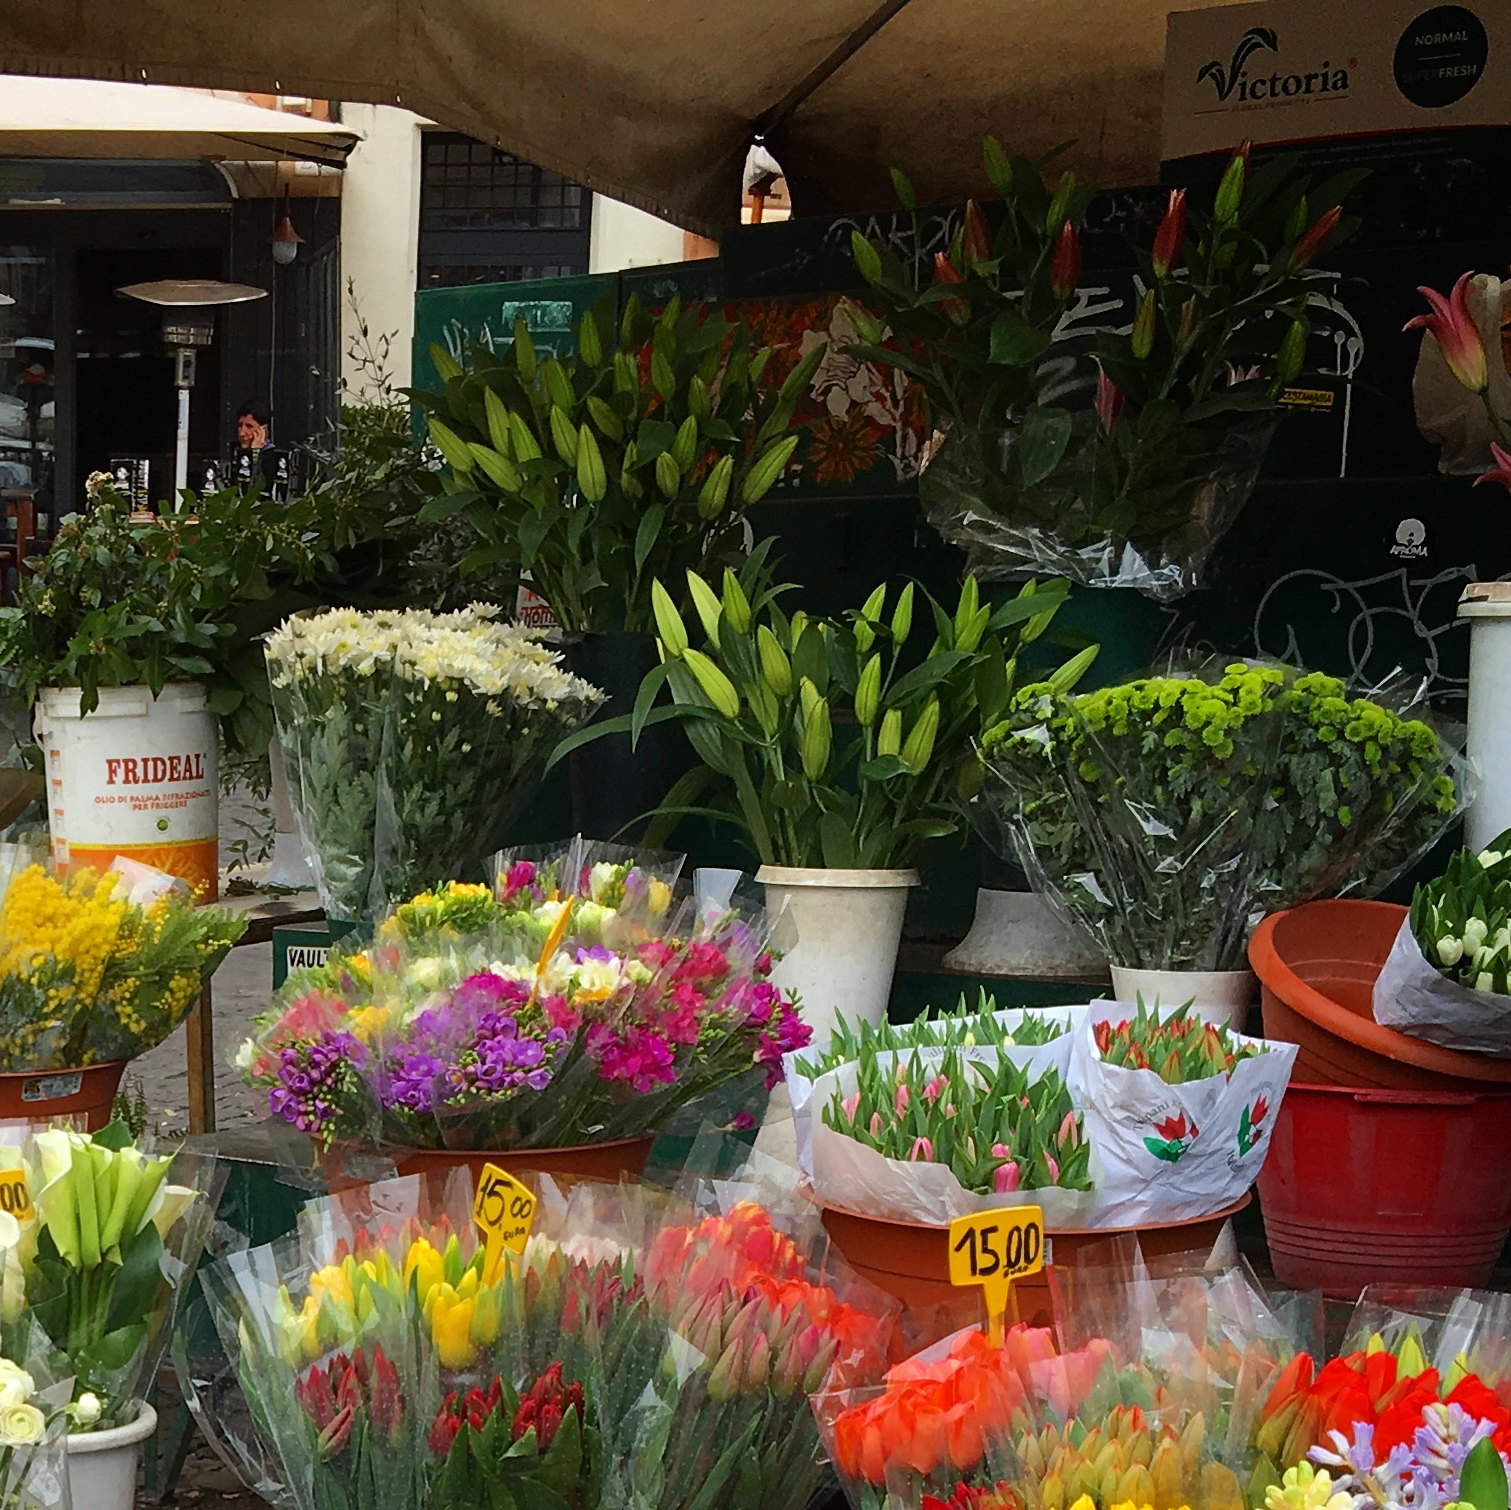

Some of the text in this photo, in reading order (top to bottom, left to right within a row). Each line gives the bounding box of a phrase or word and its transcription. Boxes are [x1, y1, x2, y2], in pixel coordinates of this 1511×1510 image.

[1415, 30, 1469, 46] NORMAL
[1196, 27, 1349, 102] Victoria
[105, 753, 204, 785] FRIDEAL
[94, 796, 116, 804] OLIO
[117, 795, 127, 803] DI
[130, 794, 161, 803] PALMA
